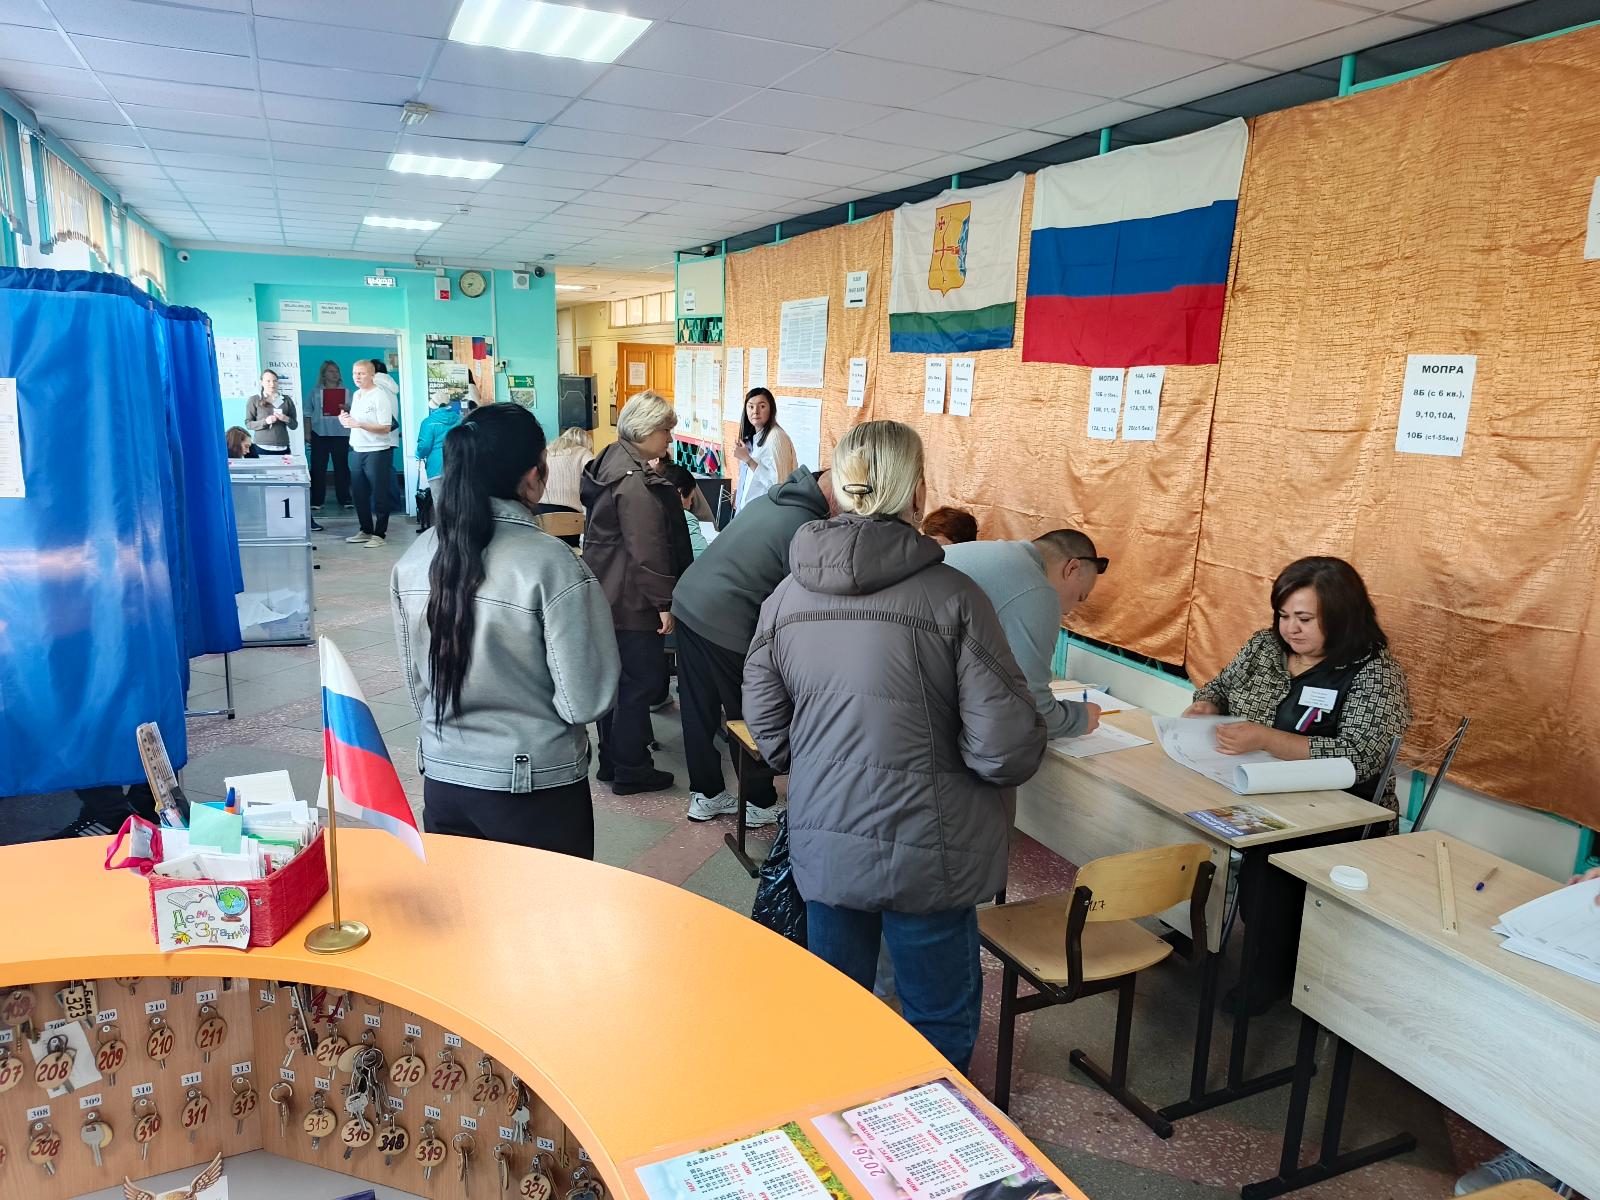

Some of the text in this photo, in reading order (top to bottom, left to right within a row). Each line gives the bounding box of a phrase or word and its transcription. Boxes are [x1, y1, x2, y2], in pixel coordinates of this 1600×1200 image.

[1422, 365, 1464, 374] МОПРА
[1427, 390, 1436, 398] (с
[1415, 411, 1456, 420] 9,10,10А,
[281, 497, 294, 518] 1
[172, 909, 216, 931] День
[194, 921, 250, 943] Знаний
[200, 992, 215, 1001] 211
[65, 996, 86, 1019] 323
[149, 1003, 165, 1011] 210
[99, 1011, 116, 1021] 209
[199, 1026, 223, 1048] 211
[407, 1026, 420, 1036] 216
[150, 1034, 173, 1057] 210
[447, 1036, 460, 1046] 217
[98, 1047, 124, 1071] 209
[317, 1044, 345, 1061] 214
[0, 1065, 22, 1085] 07
[36, 1061, 69, 1082] 208
[234, 1064, 250, 1074] 313
[282, 1071, 294, 1080] 314
[392, 1063, 421, 1083] 216
[184, 1075, 199, 1084] 311
[431, 1069, 463, 1091] 217
[135, 1085, 152, 1095] 310
[472, 1083, 500, 1102] 218
[83, 1096, 100, 1107] 309
[233, 1095, 256, 1116] 313
[31, 1108, 49, 1119] 308
[184, 1103, 208, 1128] 311
[427, 1108, 440, 1118] 319
[139, 1118, 161, 1141] 310
[305, 1115, 329, 1133] 315
[463, 1118, 476, 1128] 320
[31, 1138, 61, 1157] 308
[417, 1145, 443, 1162] 319
[539, 1140, 553, 1150] 324
[852, 1148, 886, 1177] 2026
[520, 1179, 548, 1199] 324
